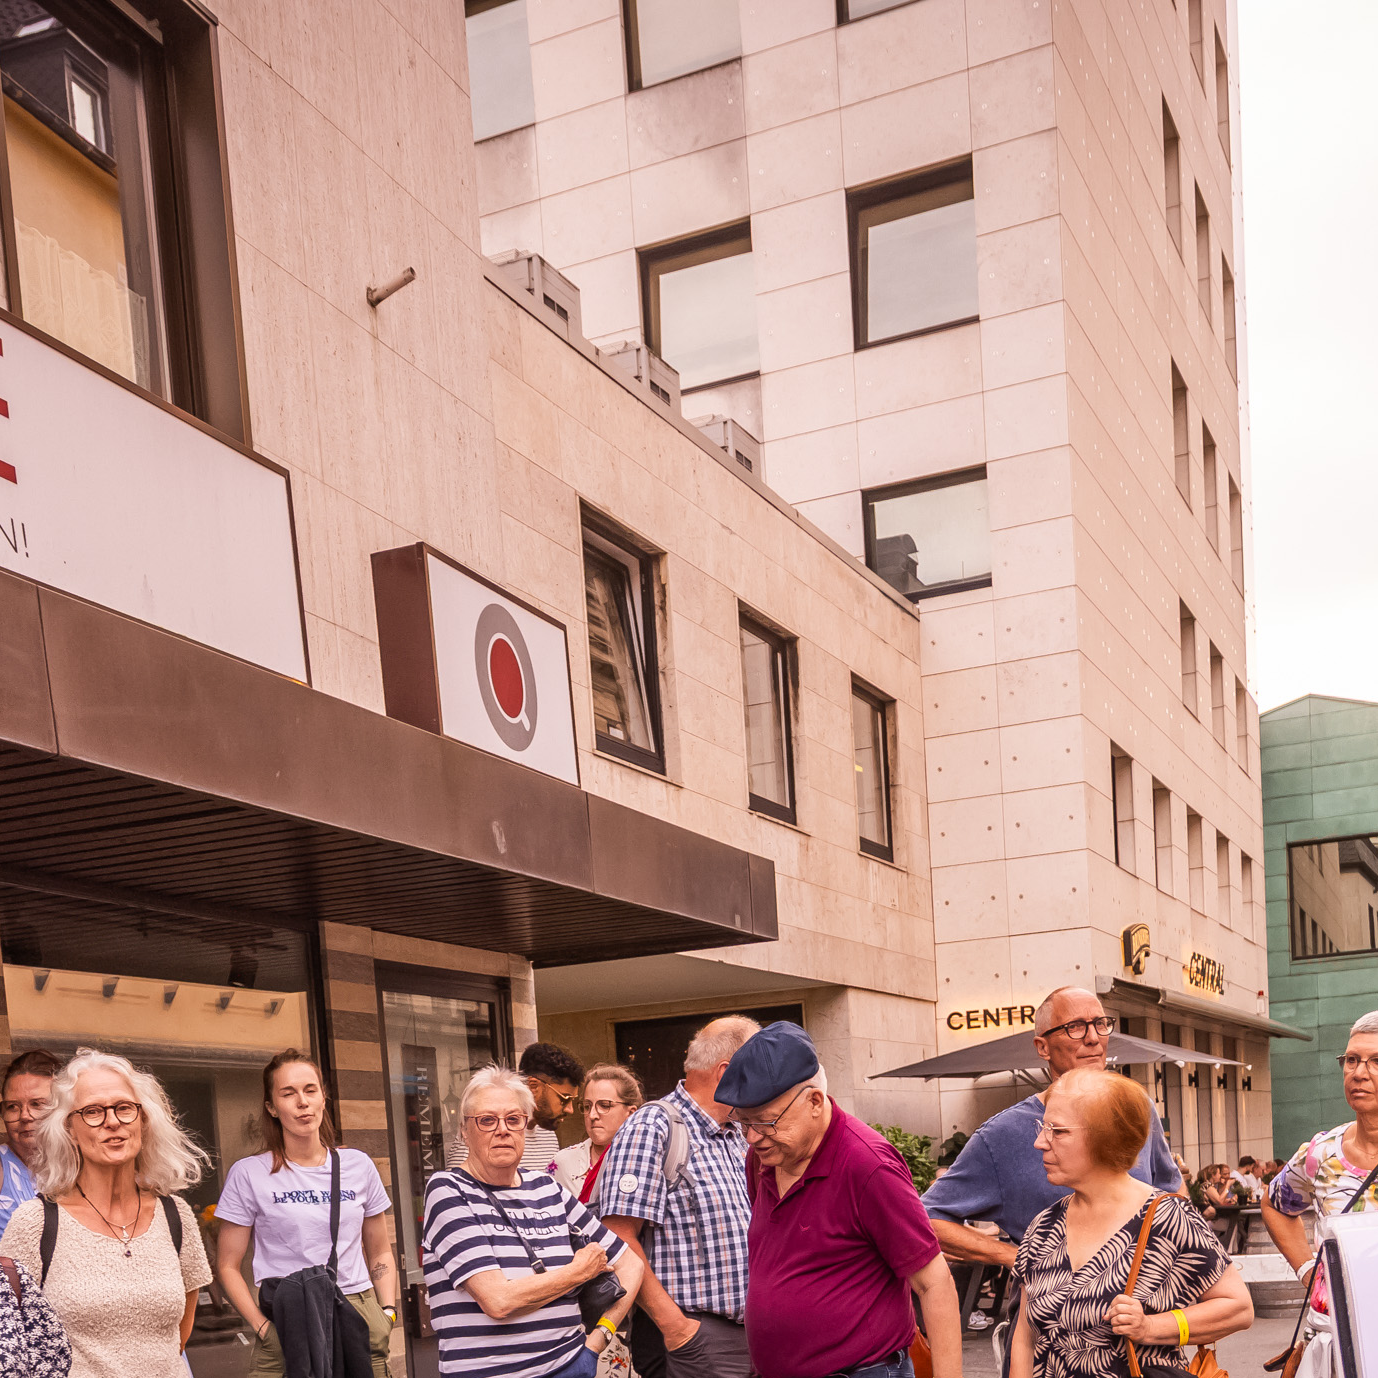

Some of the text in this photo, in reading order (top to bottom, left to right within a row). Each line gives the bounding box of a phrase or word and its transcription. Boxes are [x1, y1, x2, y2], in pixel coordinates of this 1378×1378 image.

[1189, 952, 1224, 995] CENTRAL
[947, 1005, 1035, 1030] CENTR
[417, 1067, 434, 1180] REMEM
[290, 1195, 320, 1204] YOUR
